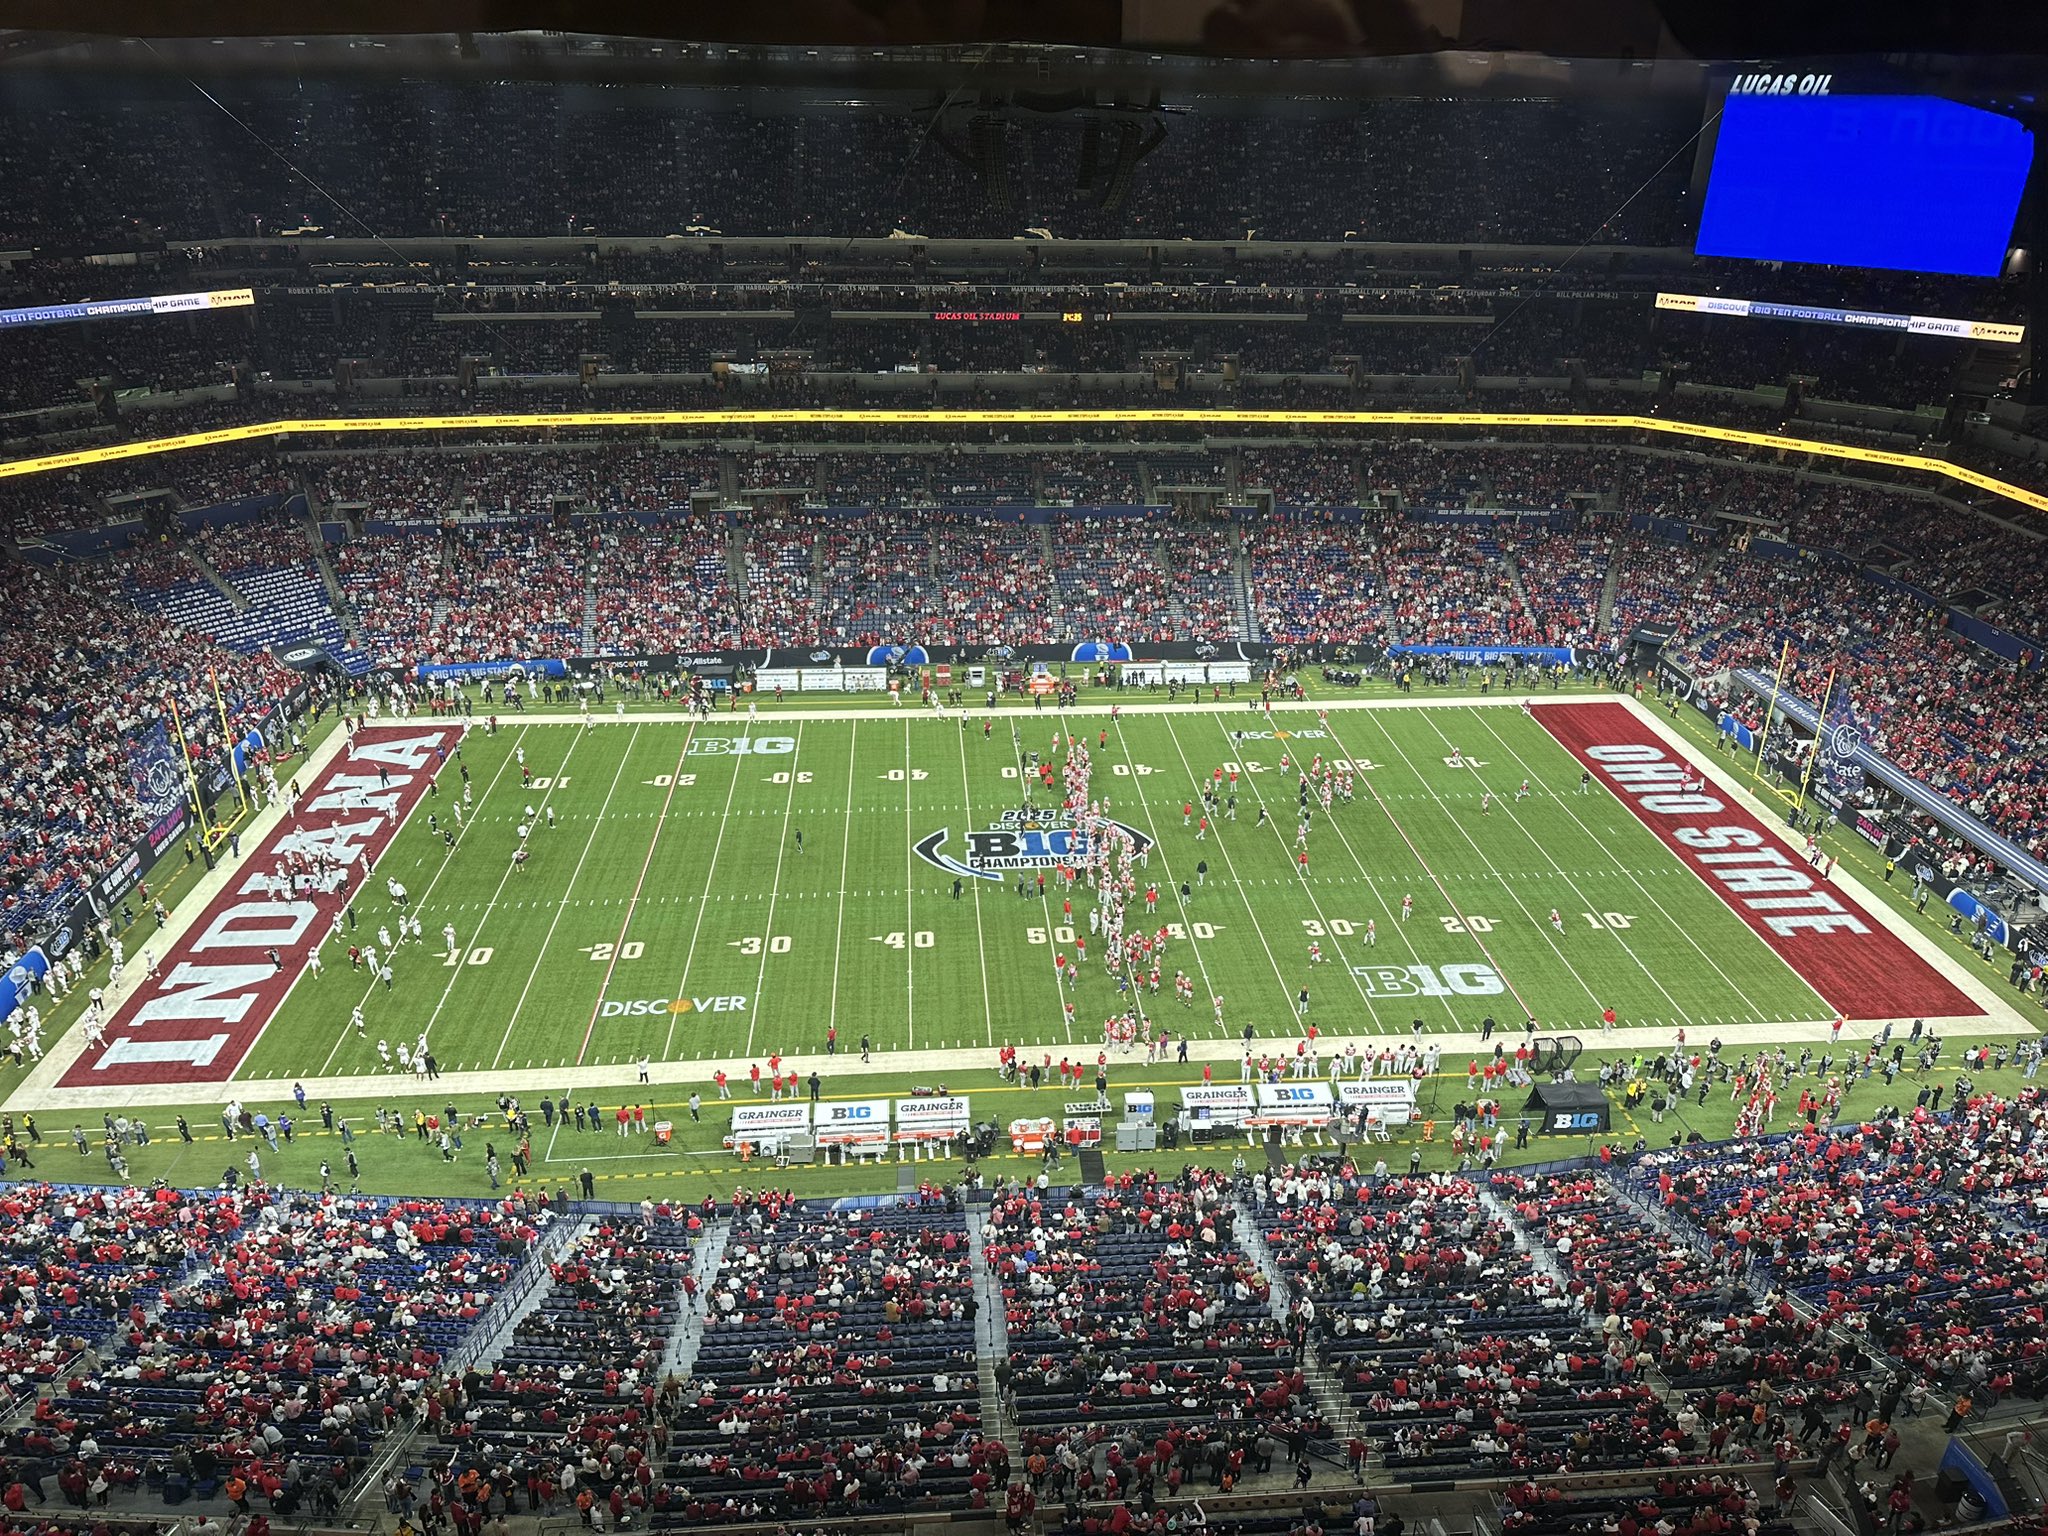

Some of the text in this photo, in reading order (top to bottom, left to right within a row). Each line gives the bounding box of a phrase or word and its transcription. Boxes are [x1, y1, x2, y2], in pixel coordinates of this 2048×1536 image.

[1729, 74, 1833, 96] LUCAS OIL
[3, 298, 200, 324] TEN FOOTBALL CHAMPIONSHIP GAME
[934, 312, 1020, 320] LUCAS OIL STADIUM
[1708, 302, 1961, 332] DISCOVER BIG TEN FOOTBALL CHAMPIONSHIP GAME
[290, 650, 310, 659] FOX
[692, 657, 722, 665] Allstate
[1484, 651, 1498, 661] BIG
[432, 670, 449, 679] BIG
[470, 668, 486, 676] BIG
[1779, 695, 1816, 722] STADIUM
[1231, 730, 1328, 740] DISCOVER
[1112, 764, 1153, 776] 40
[1221, 762, 1266, 774] 30
[1332, 758, 1374, 771] 20
[654, 774, 697, 787] 20
[771, 772, 813, 784] 30
[890, 769, 930, 781] 40
[531, 776, 572, 790] 10
[1003, 810, 1055, 820] 2025
[168, 822, 186, 842] SAVED
[990, 821, 1070, 830] DISCOVER
[1584, 744, 1872, 938] OHIO STATE
[102, 881, 112, 895] WE
[110, 868, 125, 885] GIVE
[122, 851, 140, 874] BLOOD
[92, 732, 447, 1070] INDIANA
[1302, 919, 1354, 936] 30
[1440, 916, 1494, 933] 20
[1582, 912, 1632, 929] 10
[1026, 926, 1075, 944] 50
[1167, 922, 1215, 939] 40
[740, 936, 792, 955] 30
[884, 931, 935, 949] 40
[442, 947, 494, 966] 10
[589, 941, 645, 961] 20
[600, 995, 748, 1018] DISCOVER
[1186, 1090, 1248, 1100] GRAINGER
[1344, 1086, 1406, 1096] GRAINGER
[900, 1102, 964, 1112] GRAINGER
[738, 1109, 803, 1120] GRAINGER
